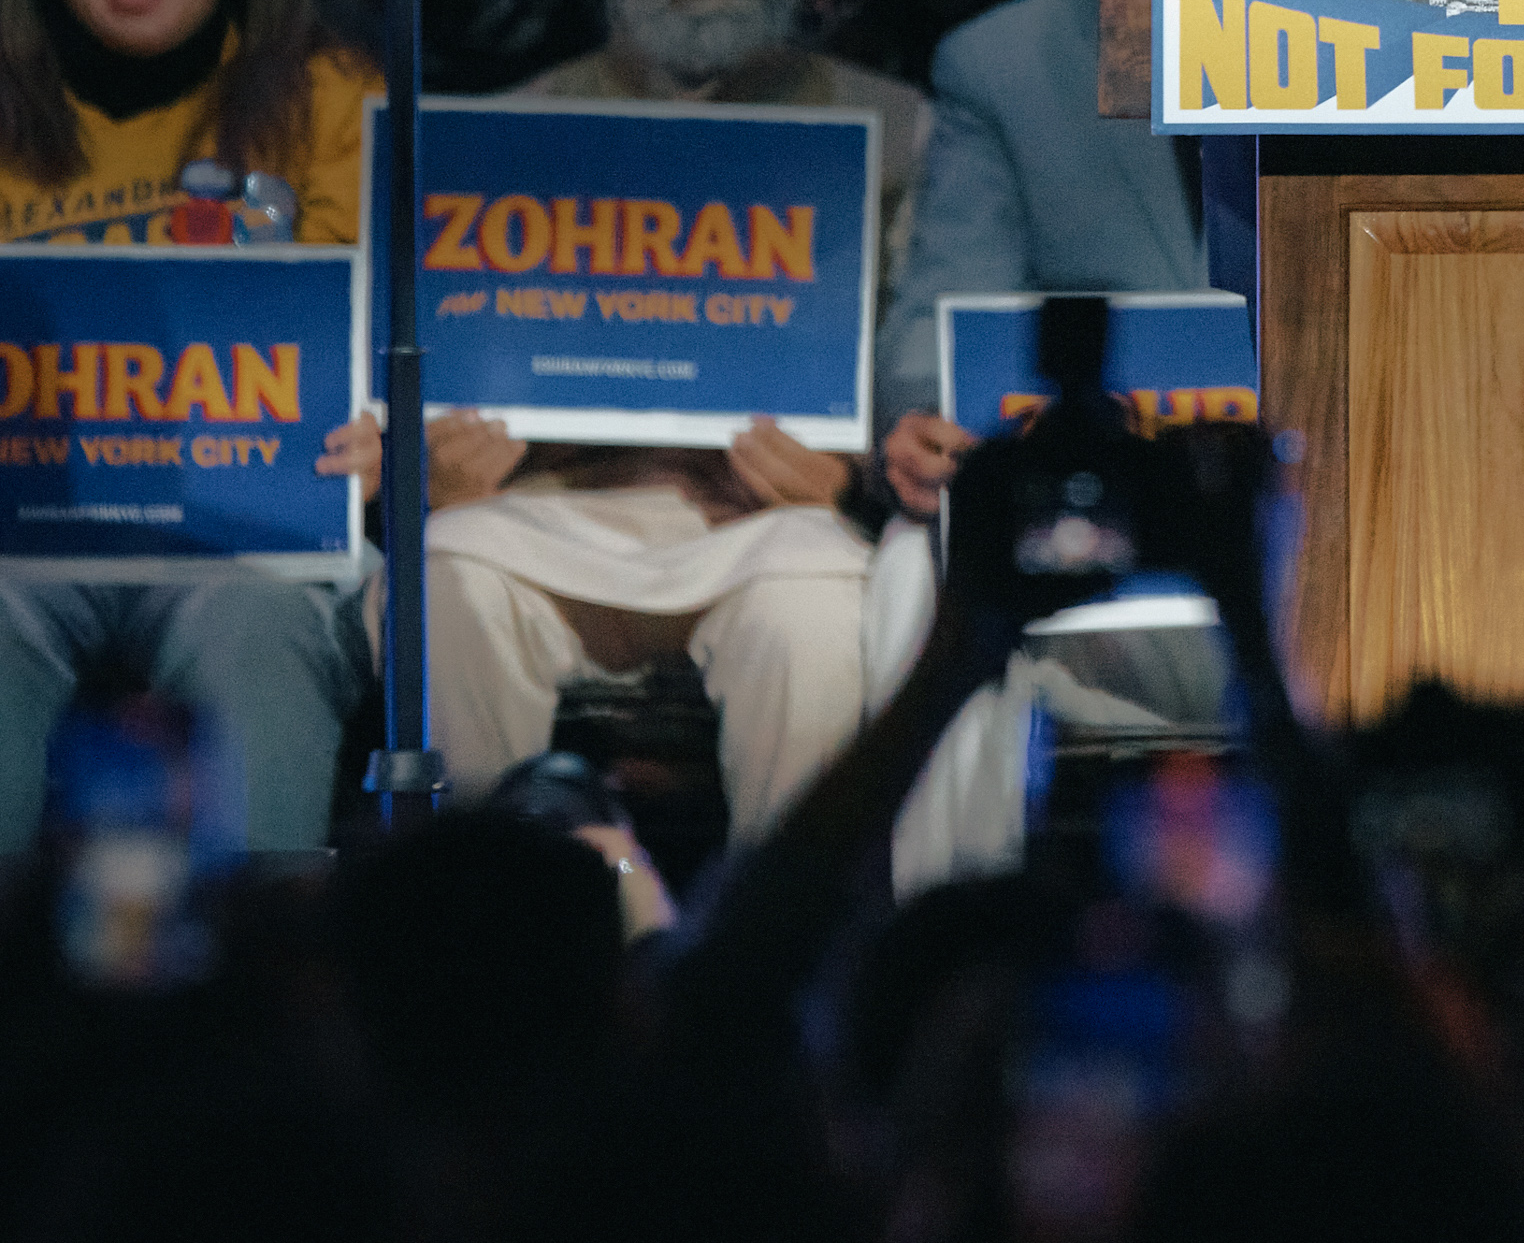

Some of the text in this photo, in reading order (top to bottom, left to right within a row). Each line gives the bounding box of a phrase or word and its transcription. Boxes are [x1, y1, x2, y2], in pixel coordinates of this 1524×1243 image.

[422, 194, 815, 281] ZOHRAN
[496, 288, 588, 320] NEW
[596, 290, 697, 323] YORK
[705, 293, 795, 326] CITY
[0, 341, 301, 423] HRAN
[80, 436, 183, 466] YORK
[190, 437, 281, 468] CITY
